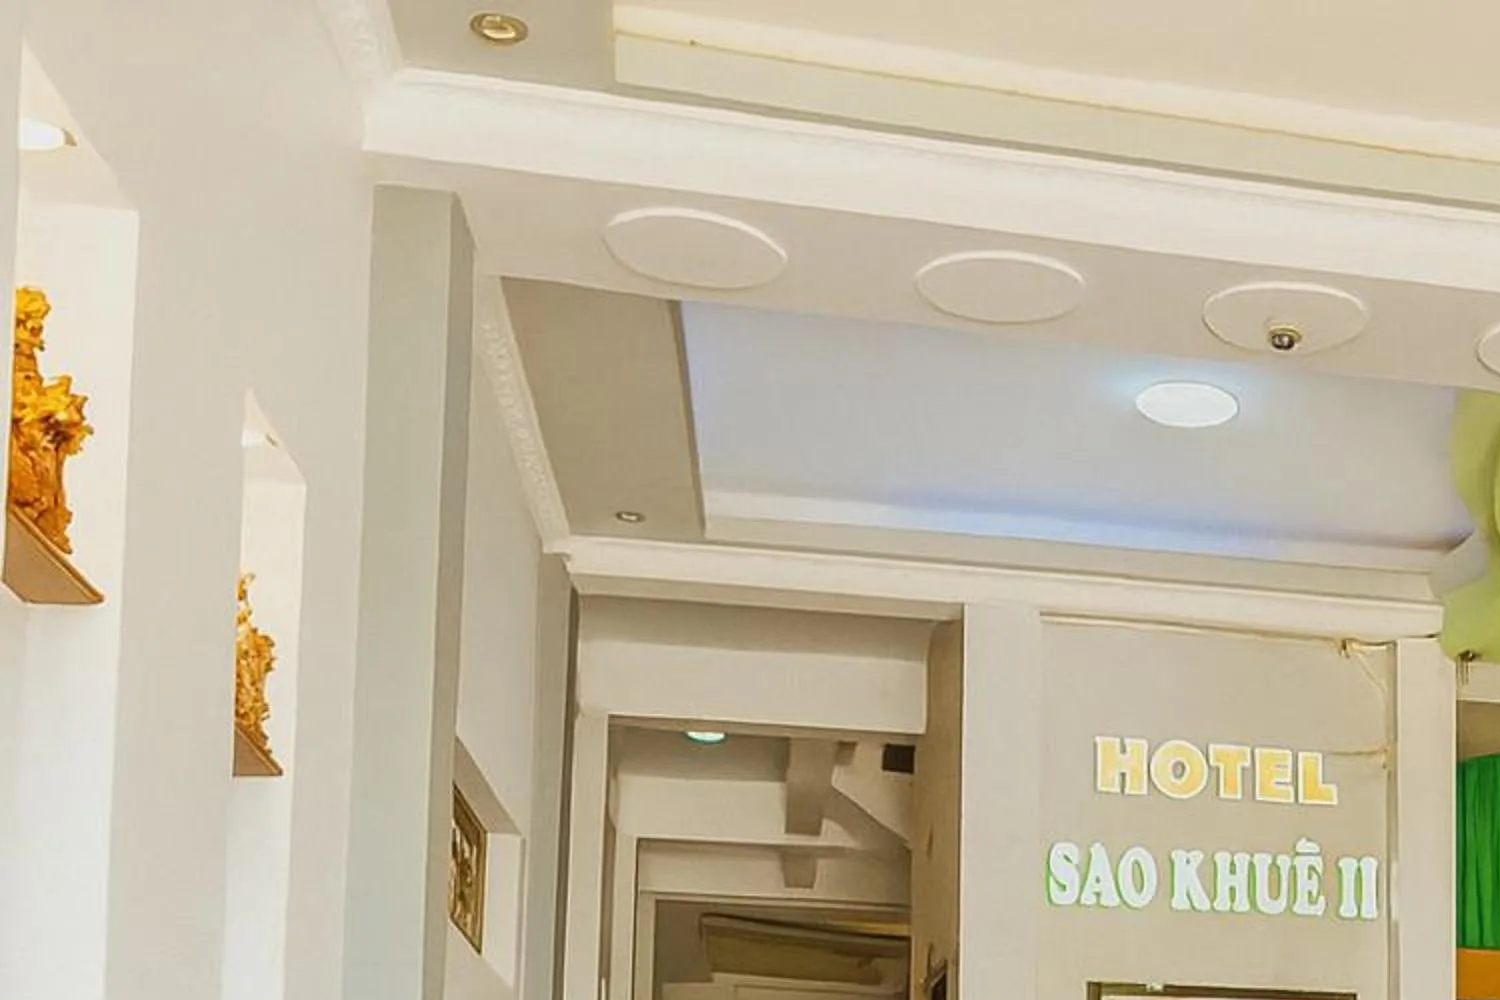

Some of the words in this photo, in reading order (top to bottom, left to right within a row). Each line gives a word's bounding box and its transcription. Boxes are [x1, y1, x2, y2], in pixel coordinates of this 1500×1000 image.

[1095, 735, 1339, 805] HOTEL
[1046, 841, 1158, 909] SAO
[1169, 837, 1325, 916] KHUÊ
[1337, 856, 1380, 920] II
